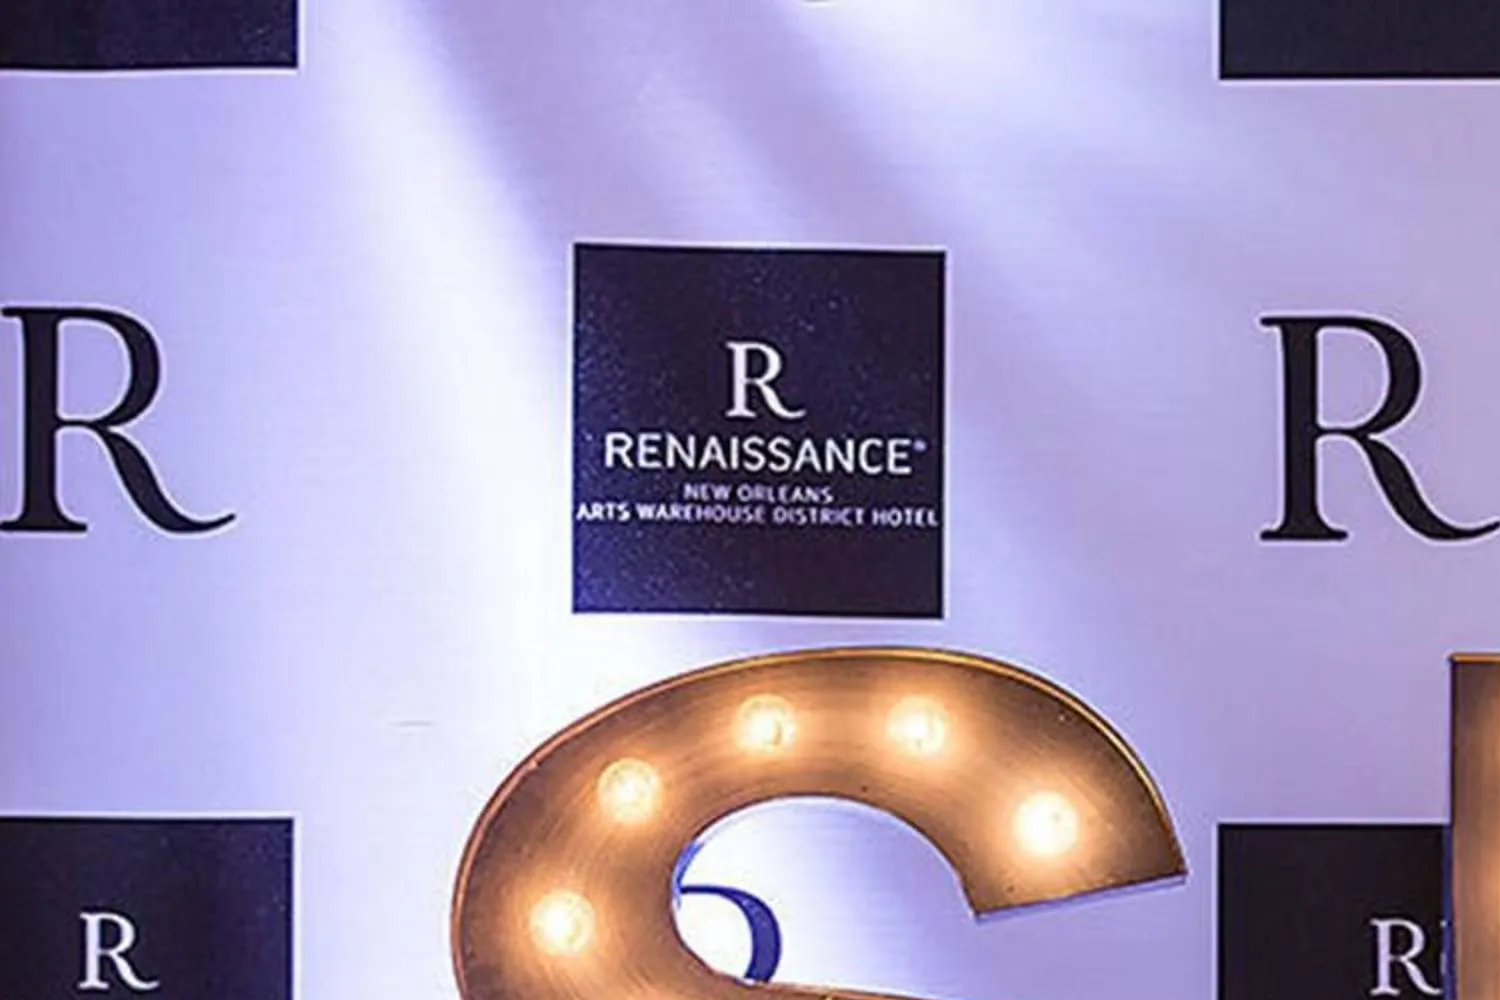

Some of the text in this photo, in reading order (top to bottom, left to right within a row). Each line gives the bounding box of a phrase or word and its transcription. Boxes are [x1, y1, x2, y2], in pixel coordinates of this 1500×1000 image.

[725, 341, 806, 420] R
[1, 306, 236, 535] R
[576, 502, 939, 528] ARTS WAREHOUSE DISTRICT HOTEL
[683, 484, 834, 504] NEW ORLEANS
[77, 911, 160, 990] R
[1370, 918, 1443, 996] R
